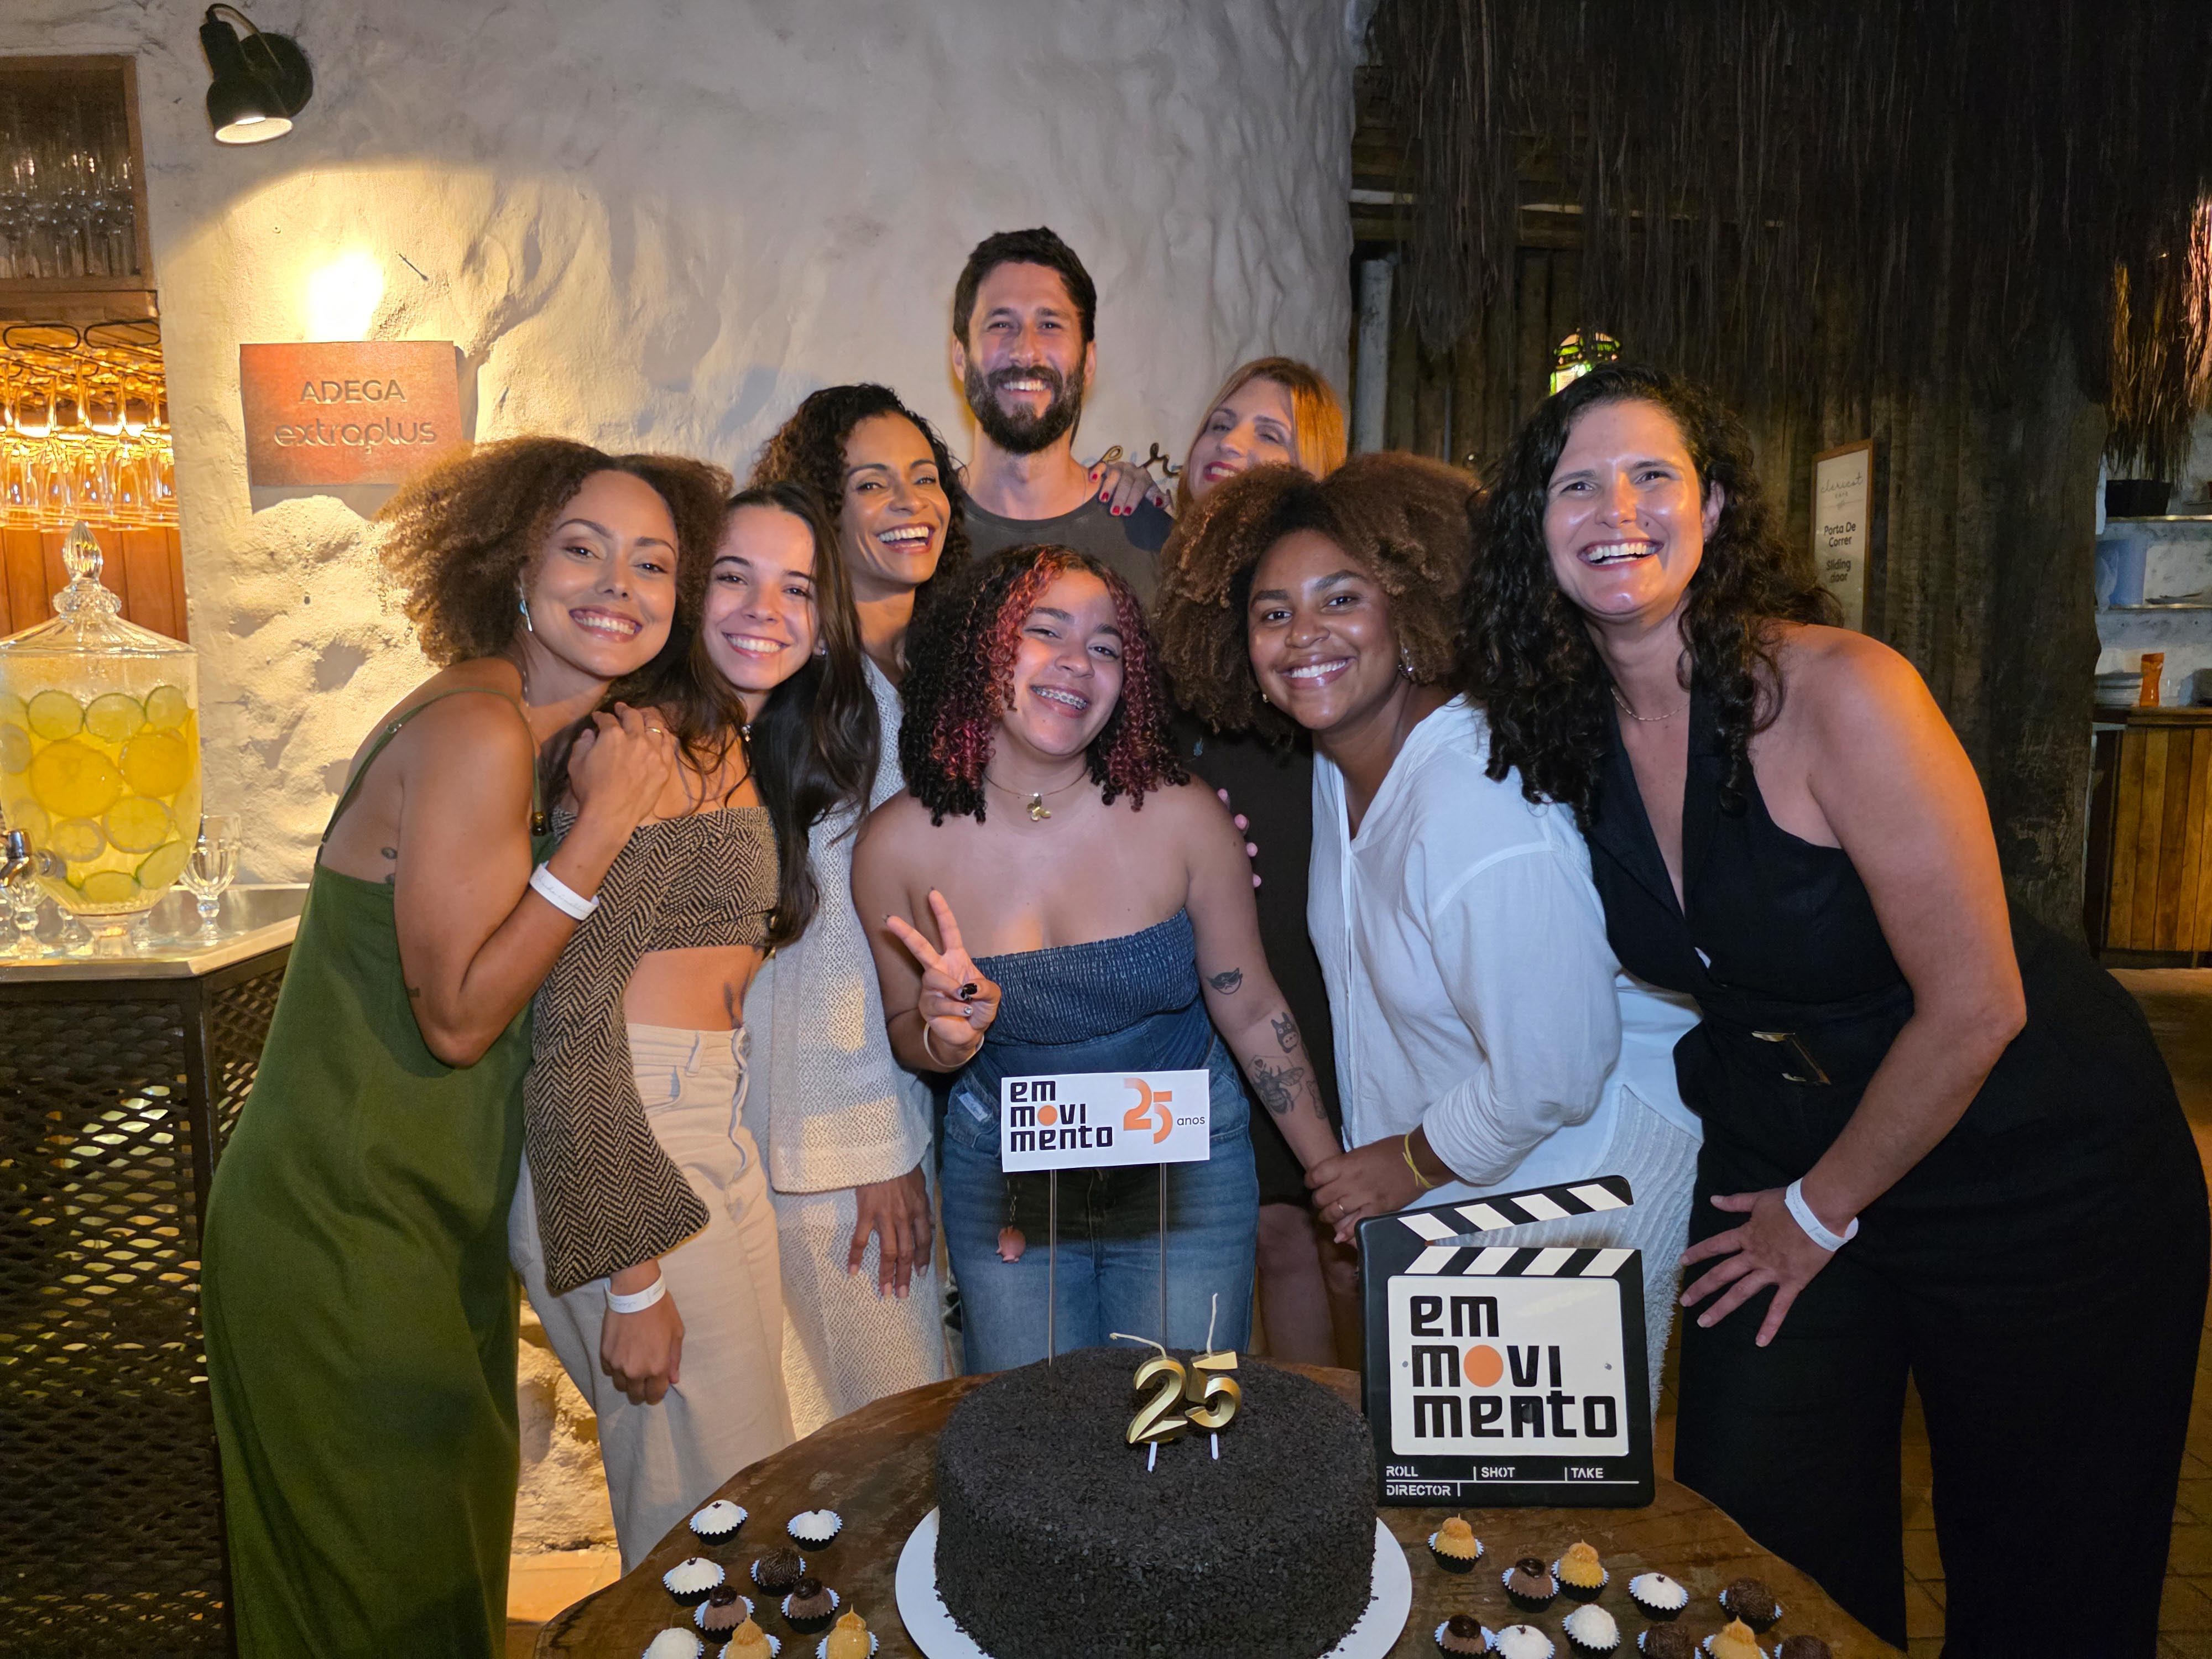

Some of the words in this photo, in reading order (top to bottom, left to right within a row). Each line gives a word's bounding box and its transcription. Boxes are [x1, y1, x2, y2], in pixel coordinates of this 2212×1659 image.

[299, 379, 407, 405] ADEGA
[274, 417, 438, 455] extraplus
[1824, 525, 1844, 536] Porta
[1845, 521, 1856, 533] De
[1829, 536, 1852, 547] Correr
[1010, 1081, 1056, 1103] em
[1123, 1077, 1173, 1145] 25
[1177, 1116, 1206, 1126] anos
[1010, 1125, 1113, 1152] mento
[1410, 1296, 1499, 1337] em
[1413, 1390, 1618, 1438] mento
[1386, 1465, 1418, 1477] ROLL
[1481, 1467, 1515, 1478] SHOT
[1571, 1467, 1604, 1479] TAKE
[1386, 1485, 1451, 1496] DIRECTOR
